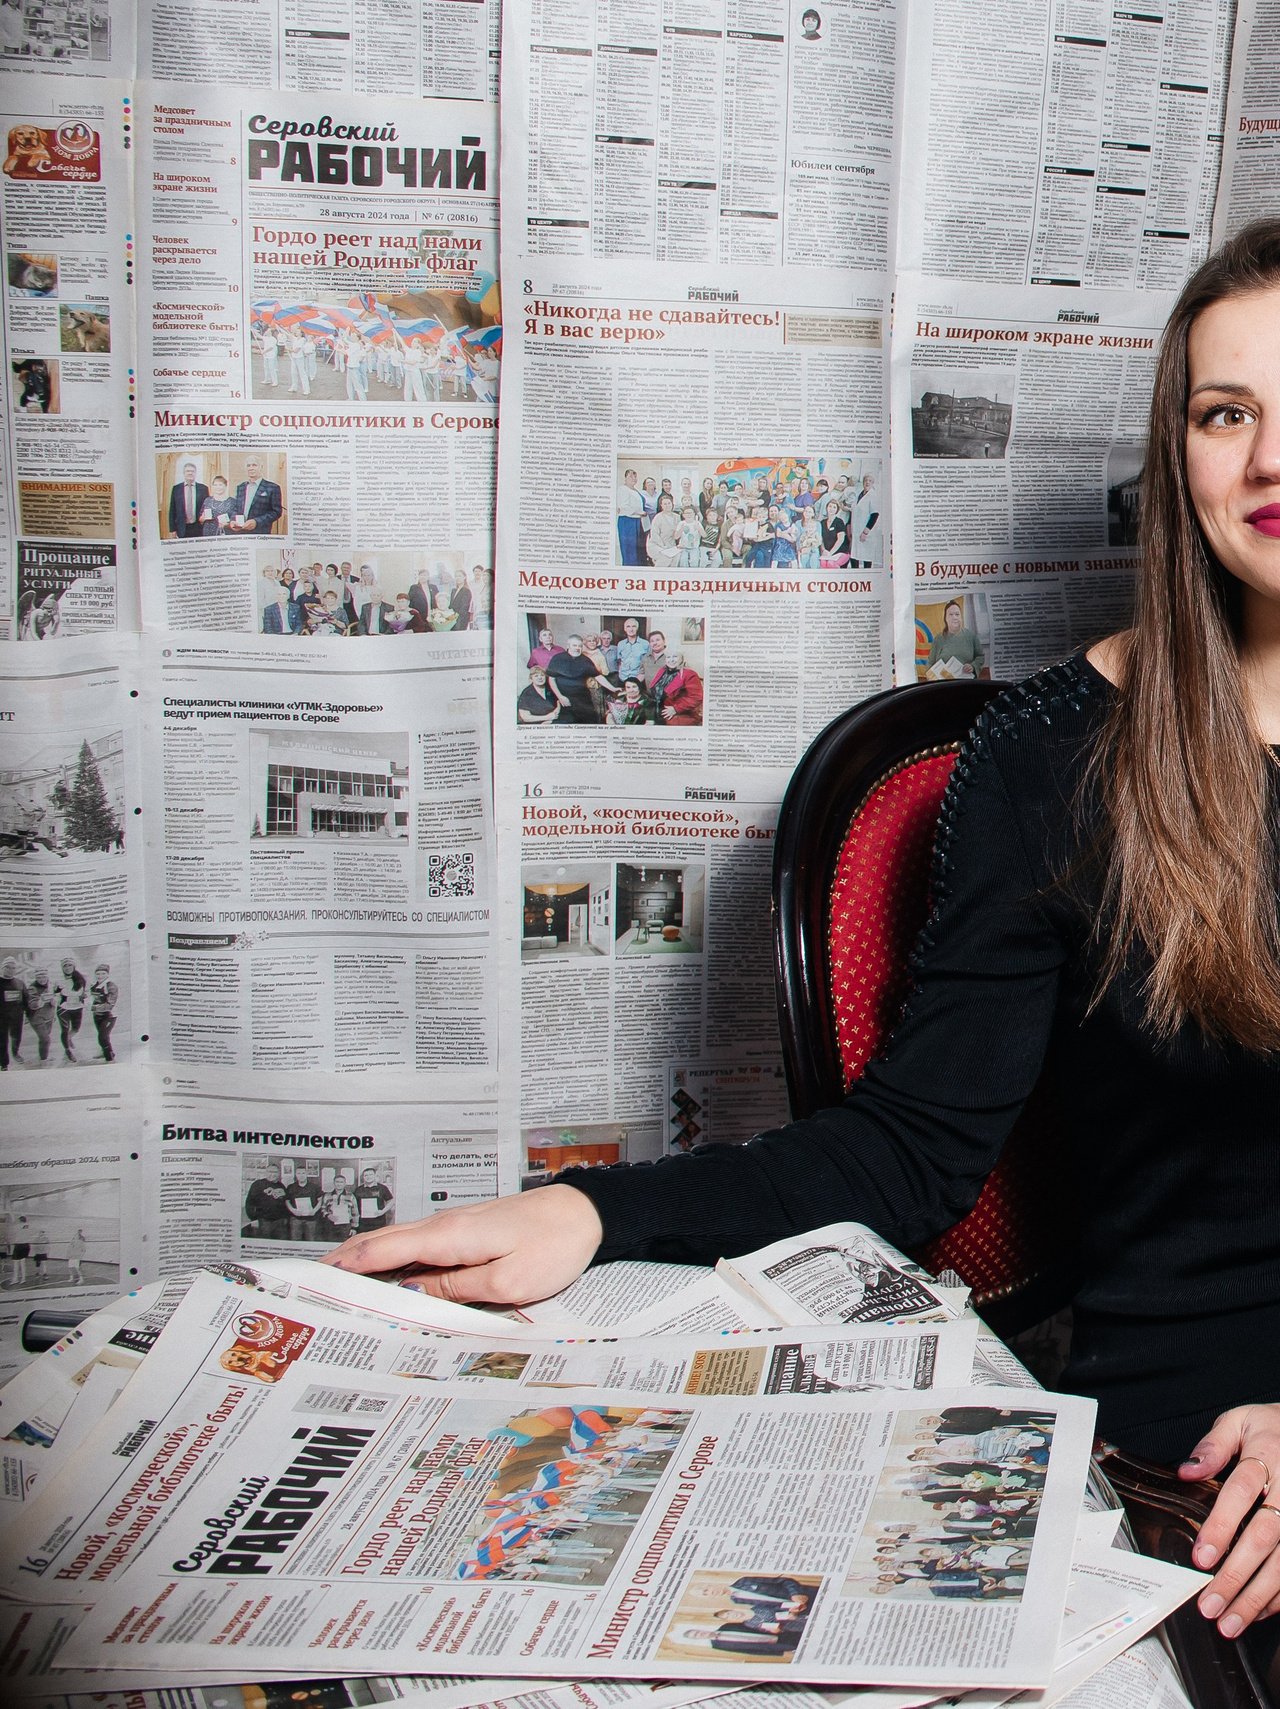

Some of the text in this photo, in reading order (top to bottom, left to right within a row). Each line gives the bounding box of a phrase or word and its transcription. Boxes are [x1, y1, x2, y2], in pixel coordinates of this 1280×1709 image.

[153, 105, 196, 115] Медсовет
[153, 127, 185, 135] столом
[165, 117, 232, 128] праздничным
[248, 114, 399, 142] Серовский
[248, 136, 487, 191] РАБОЧИЙ
[790, 159, 876, 176] Юбилеи сентября
[153, 172, 211, 184] На широком
[152, 184, 218, 194] экране жизни
[319, 209, 330, 217] 28
[332, 210, 365, 220] августа
[368, 211, 388, 220] 2024
[389, 212, 410, 222] года
[434, 213, 444, 221] 67
[446, 212, 479, 224] (20816)
[252, 226, 483, 252] Гордо реет над нами
[253, 250, 478, 273] нашей Родины флаг
[523, 279, 533, 294] 8
[687, 290, 739, 302] РАБОЧИЙ
[152, 302, 225, 311] «Космической»
[523, 300, 781, 327] «Никогда не сдавайтесь!
[152, 312, 204, 321] модельной
[152, 322, 239, 332] библиотеке быть!
[523, 319, 666, 343] Я в вас верю»
[915, 321, 1154, 349] На широком экране жизни
[152, 368, 227, 378] Собачье сердце
[154, 410, 253, 431] Министр
[259, 413, 407, 431] соцполитики
[412, 415, 425, 429] в
[21, 482, 112, 493] ВНИМАНИЕ! SOS!
[24, 548, 110, 567] Прощание
[23, 567, 102, 579] РИТУАЛЬНЫЕ
[914, 561, 926, 577] В
[930, 560, 999, 580] будущее
[1002, 564, 1011, 575] с
[1014, 560, 1080, 575] новыми
[23, 579, 72, 589] УСЛУГИ
[517, 570, 873, 596] Медсовет за праздничным столом
[163, 697, 384, 715] Специалисты клиники «УГМК-Здоровье»
[163, 709, 195, 720] ведут
[196, 711, 232, 721] прием
[233, 711, 292, 723] пациентов
[301, 713, 340, 725] Серове
[523, 782, 543, 798] 16
[522, 805, 739, 826] Новой, «космической»,
[522, 822, 627, 838] модельной
[631, 821, 740, 840] библиотеке
[166, 907, 490, 924] ВОЗМОЖНЫ ПРОТИВОПОКАЗАНИЯ. ПРОКОНСУЛЬТИРУЙТЕСЬ СО СПЕЦИАЛИСТОМ
[161, 1123, 375, 1150] Битва интеллектов
[40, 1157, 77, 1168] образца
[78, 1155, 100, 1164] 2024
[101, 1154, 121, 1165] года
[88, 1504, 162, 1582] модельной
[147, 1424, 220, 1503] библиотеке
[206, 1384, 248, 1424] быть!
[53, 1532, 118, 1581] Новой,
[105, 1423, 199, 1529] «космической»,
[205, 1425, 377, 1575] РАБОЧИЙ
[340, 1433, 460, 1576] Гордо реет над нами
[380, 1436, 487, 1576] нашей Родины флаг
[172, 1474, 271, 1574] Серовский
[586, 1435, 719, 1660] Министр соцполитики в Серове
[18, 1555, 49, 1576] 16
[519, 1599, 560, 1657] Собачье сердце
